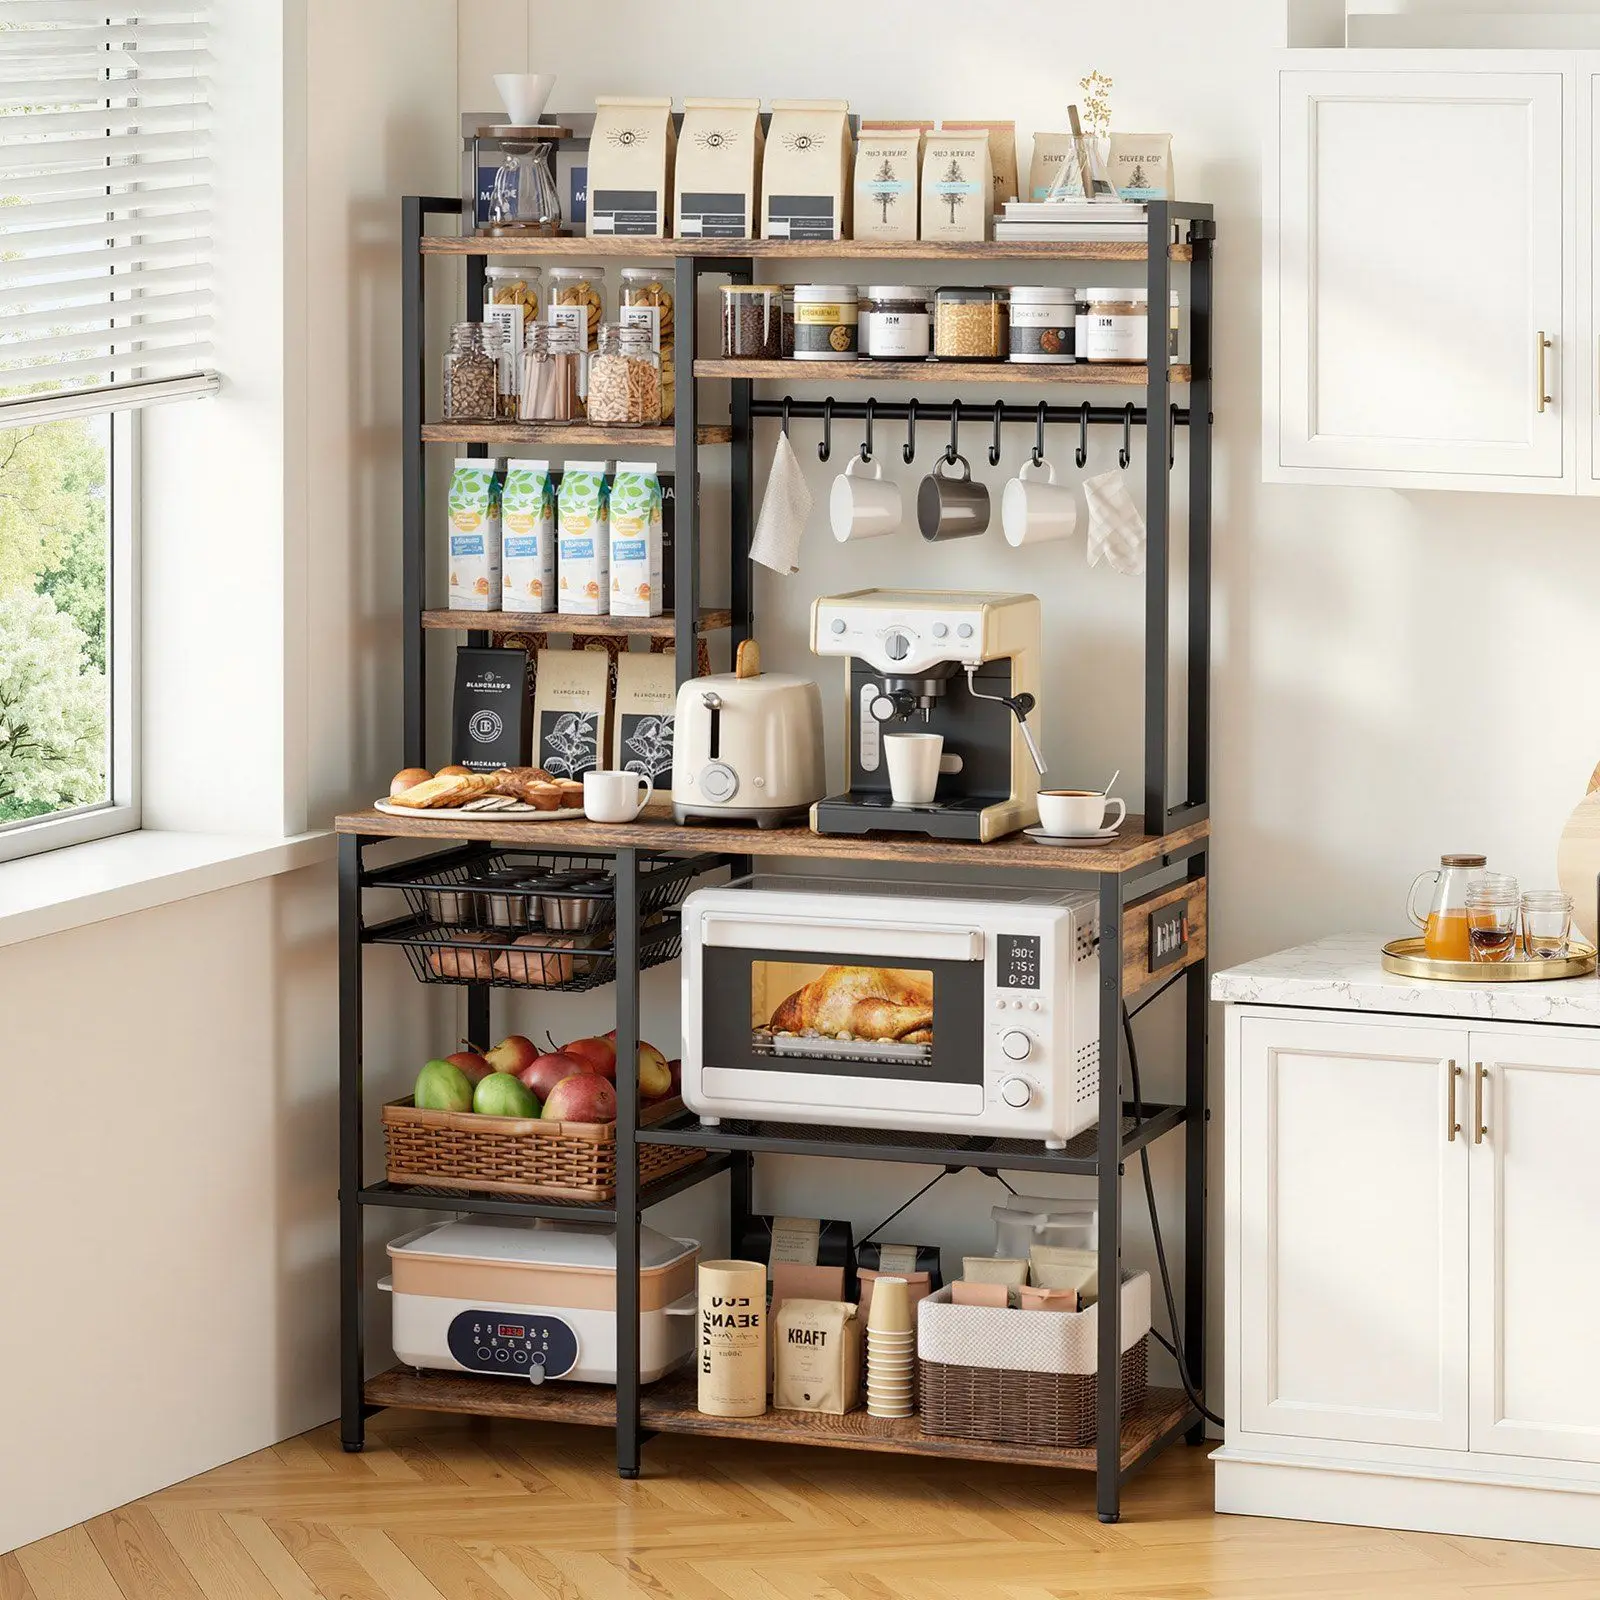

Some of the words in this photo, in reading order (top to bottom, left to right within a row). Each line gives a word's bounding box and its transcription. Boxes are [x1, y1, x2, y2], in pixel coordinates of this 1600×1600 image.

[885, 317, 900, 325] JAM
[1098, 318, 1113, 326] JAM
[787, 1328, 827, 1346] KRAFT
